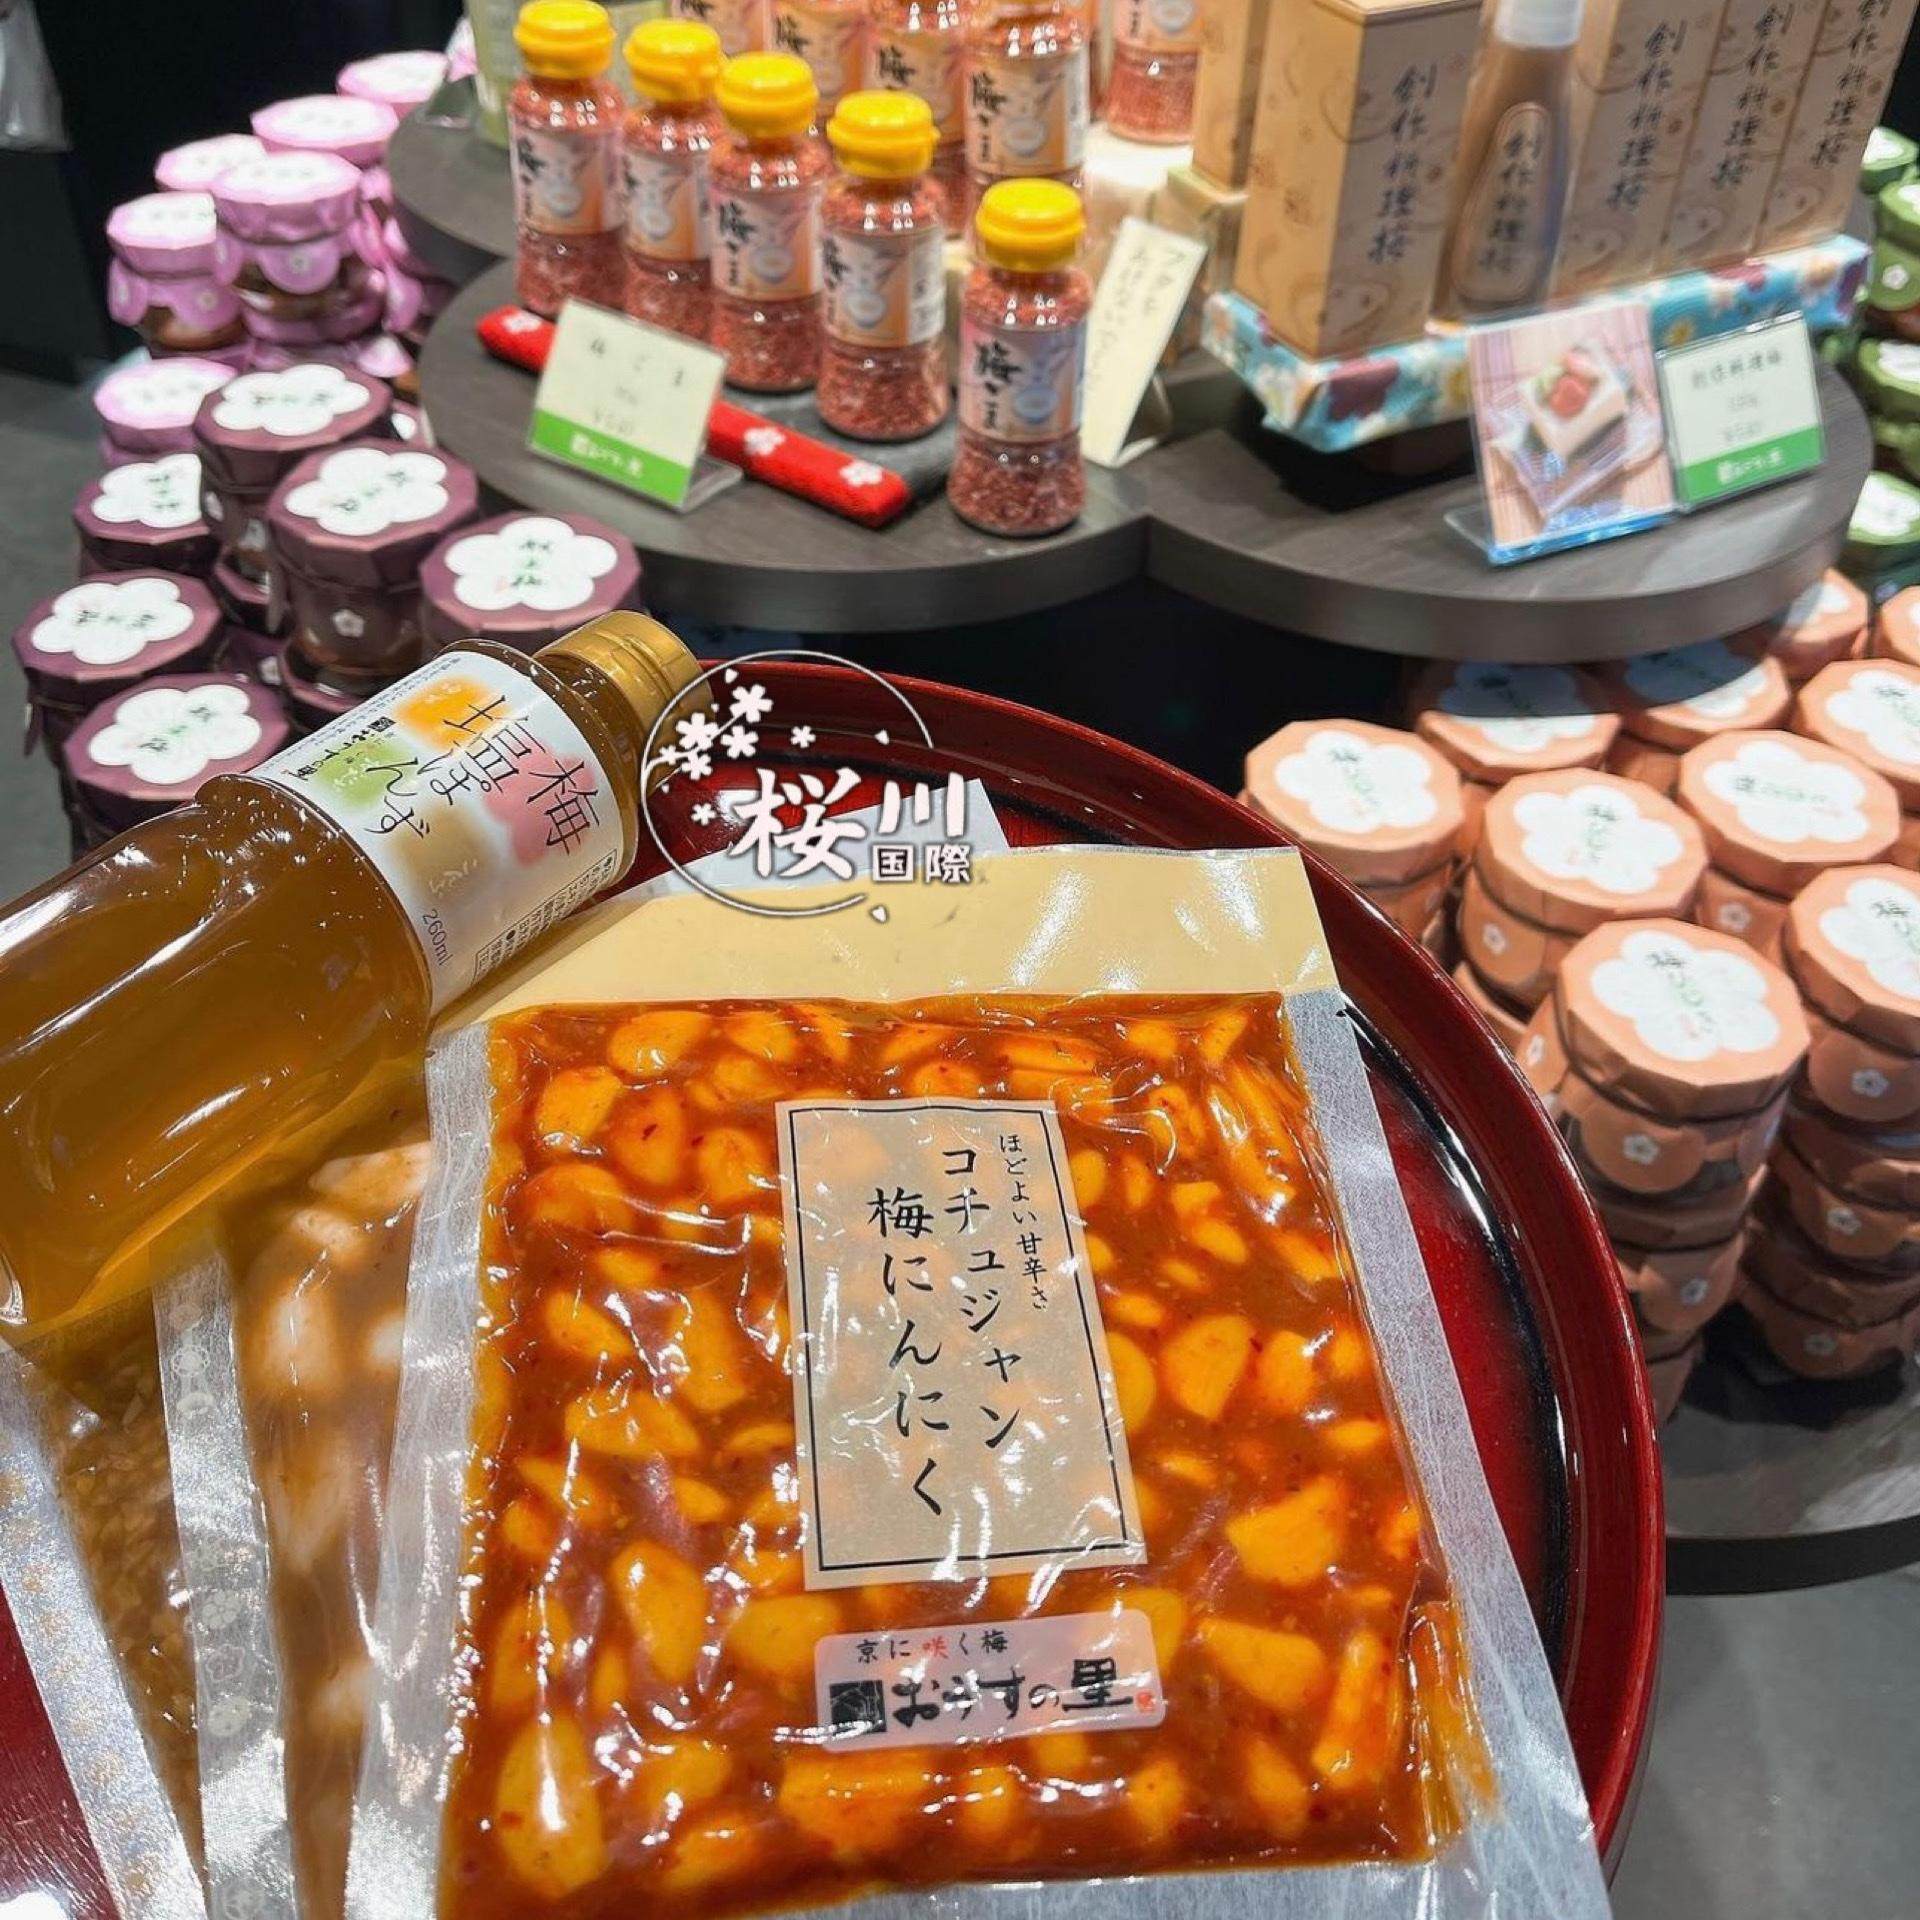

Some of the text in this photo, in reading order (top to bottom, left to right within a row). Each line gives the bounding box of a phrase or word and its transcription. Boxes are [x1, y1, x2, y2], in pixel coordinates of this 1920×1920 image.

[422, 908, 454, 967] 260ml
[942, 1147, 1023, 1450] コチュジャン
[999, 1133, 1049, 1311] ほどよい甘辛さ
[867, 1185, 950, 1517] 梅にんにく
[856, 1630, 1008, 1665] 京に咲く梅
